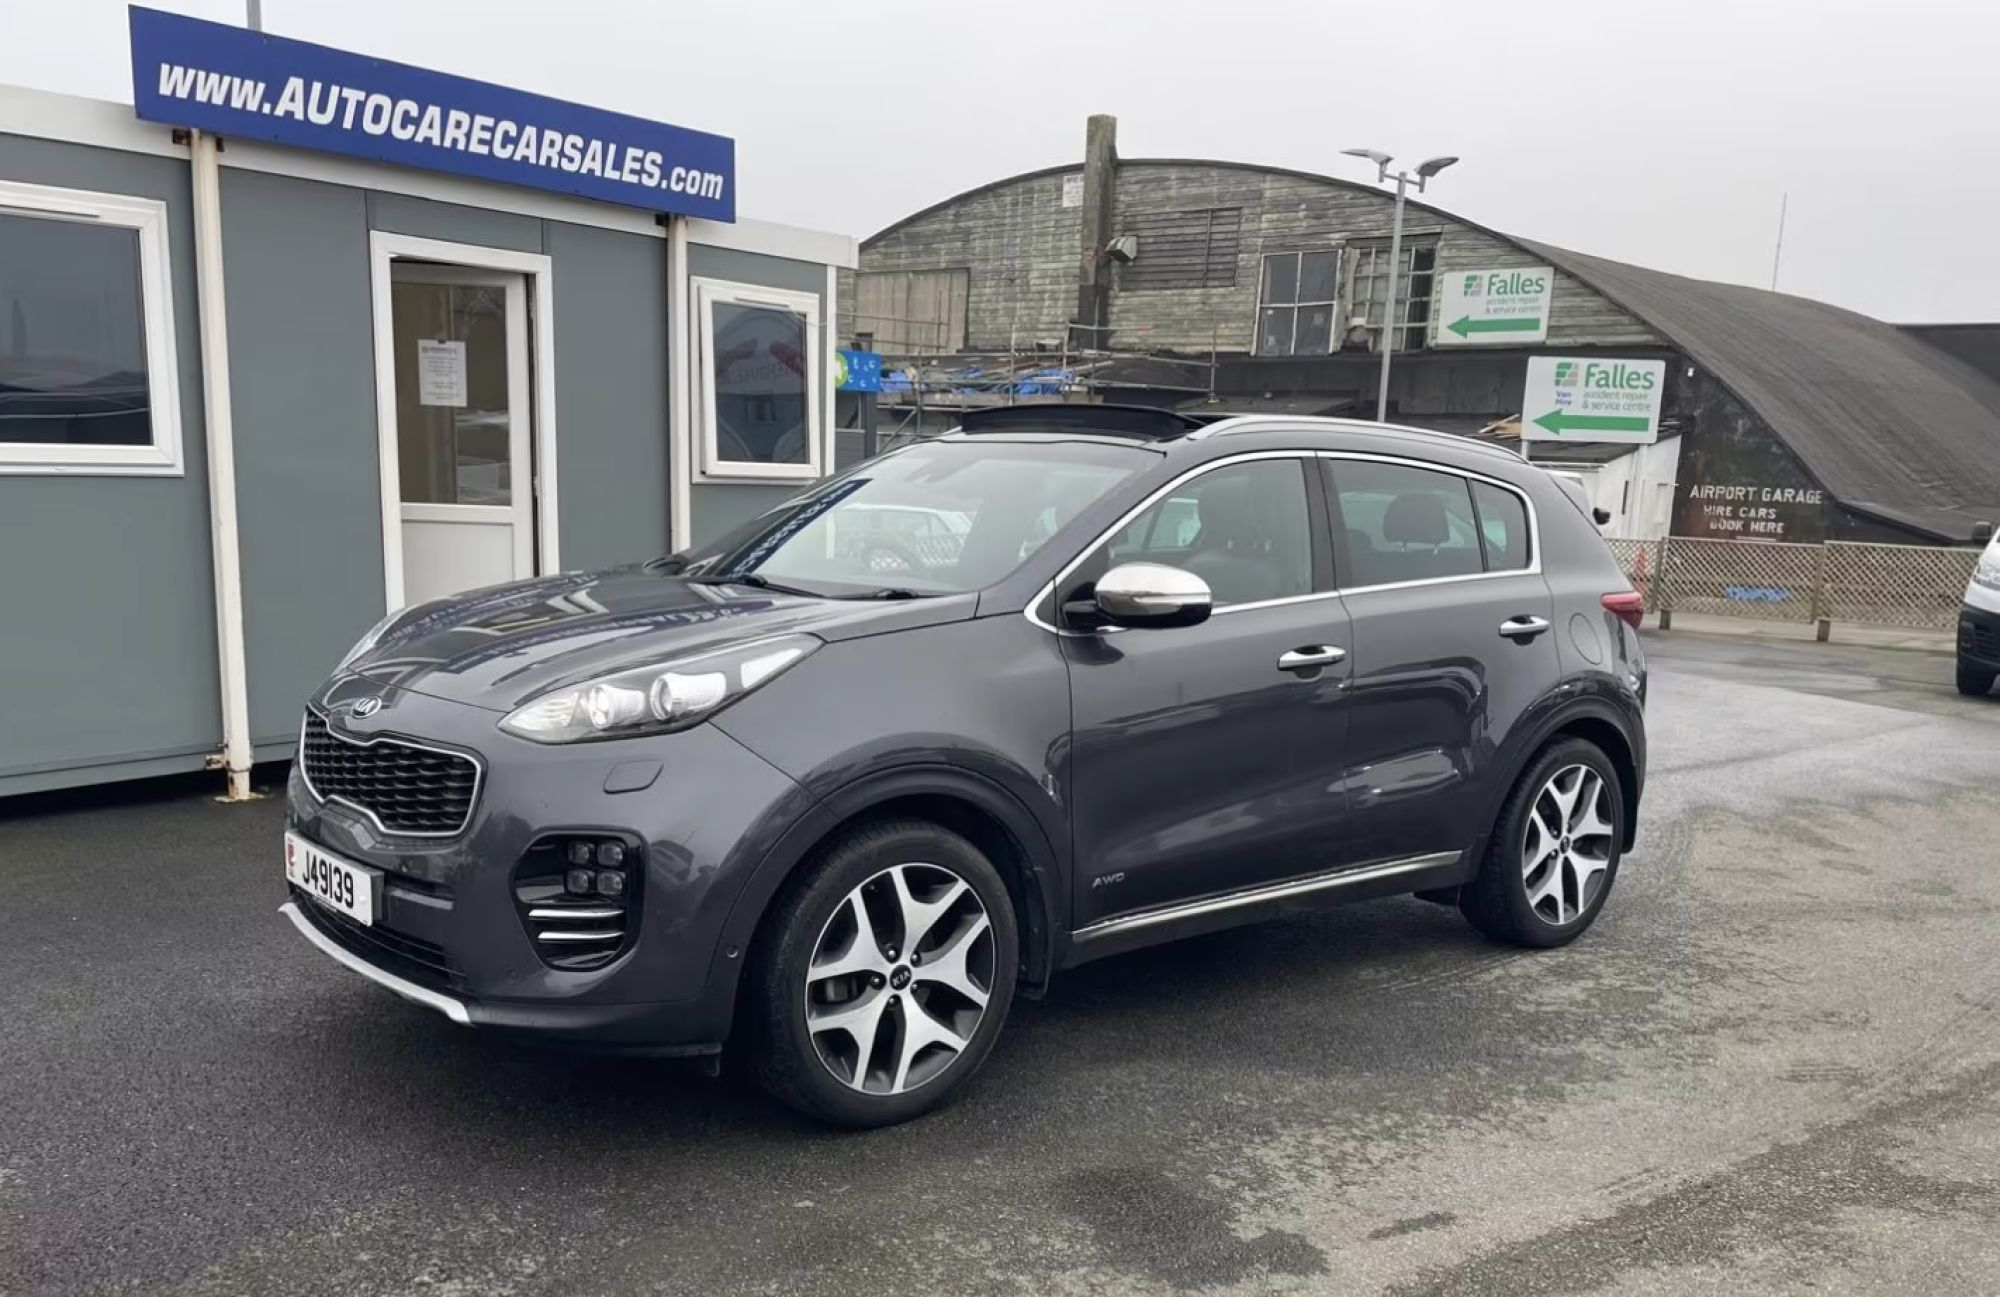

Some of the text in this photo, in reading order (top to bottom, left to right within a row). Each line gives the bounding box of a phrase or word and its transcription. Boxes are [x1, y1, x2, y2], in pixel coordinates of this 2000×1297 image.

[158, 62, 724, 200] www.AUTOCARECARSALES.com
[1487, 273, 1545, 296] Falles
[1584, 363, 1655, 389] Falles
[1583, 390, 1648, 402] accident repair
[1582, 401, 1651, 411] & service centre
[1689, 484, 1823, 504] AIRPORT GARAGE
[1703, 504, 1777, 519] HIRE CARS
[1750, 521, 1785, 534] HERE
[302, 850, 354, 909] J49139
[1092, 871, 1125, 888] AWD
[892, 970, 911, 987] KIA
